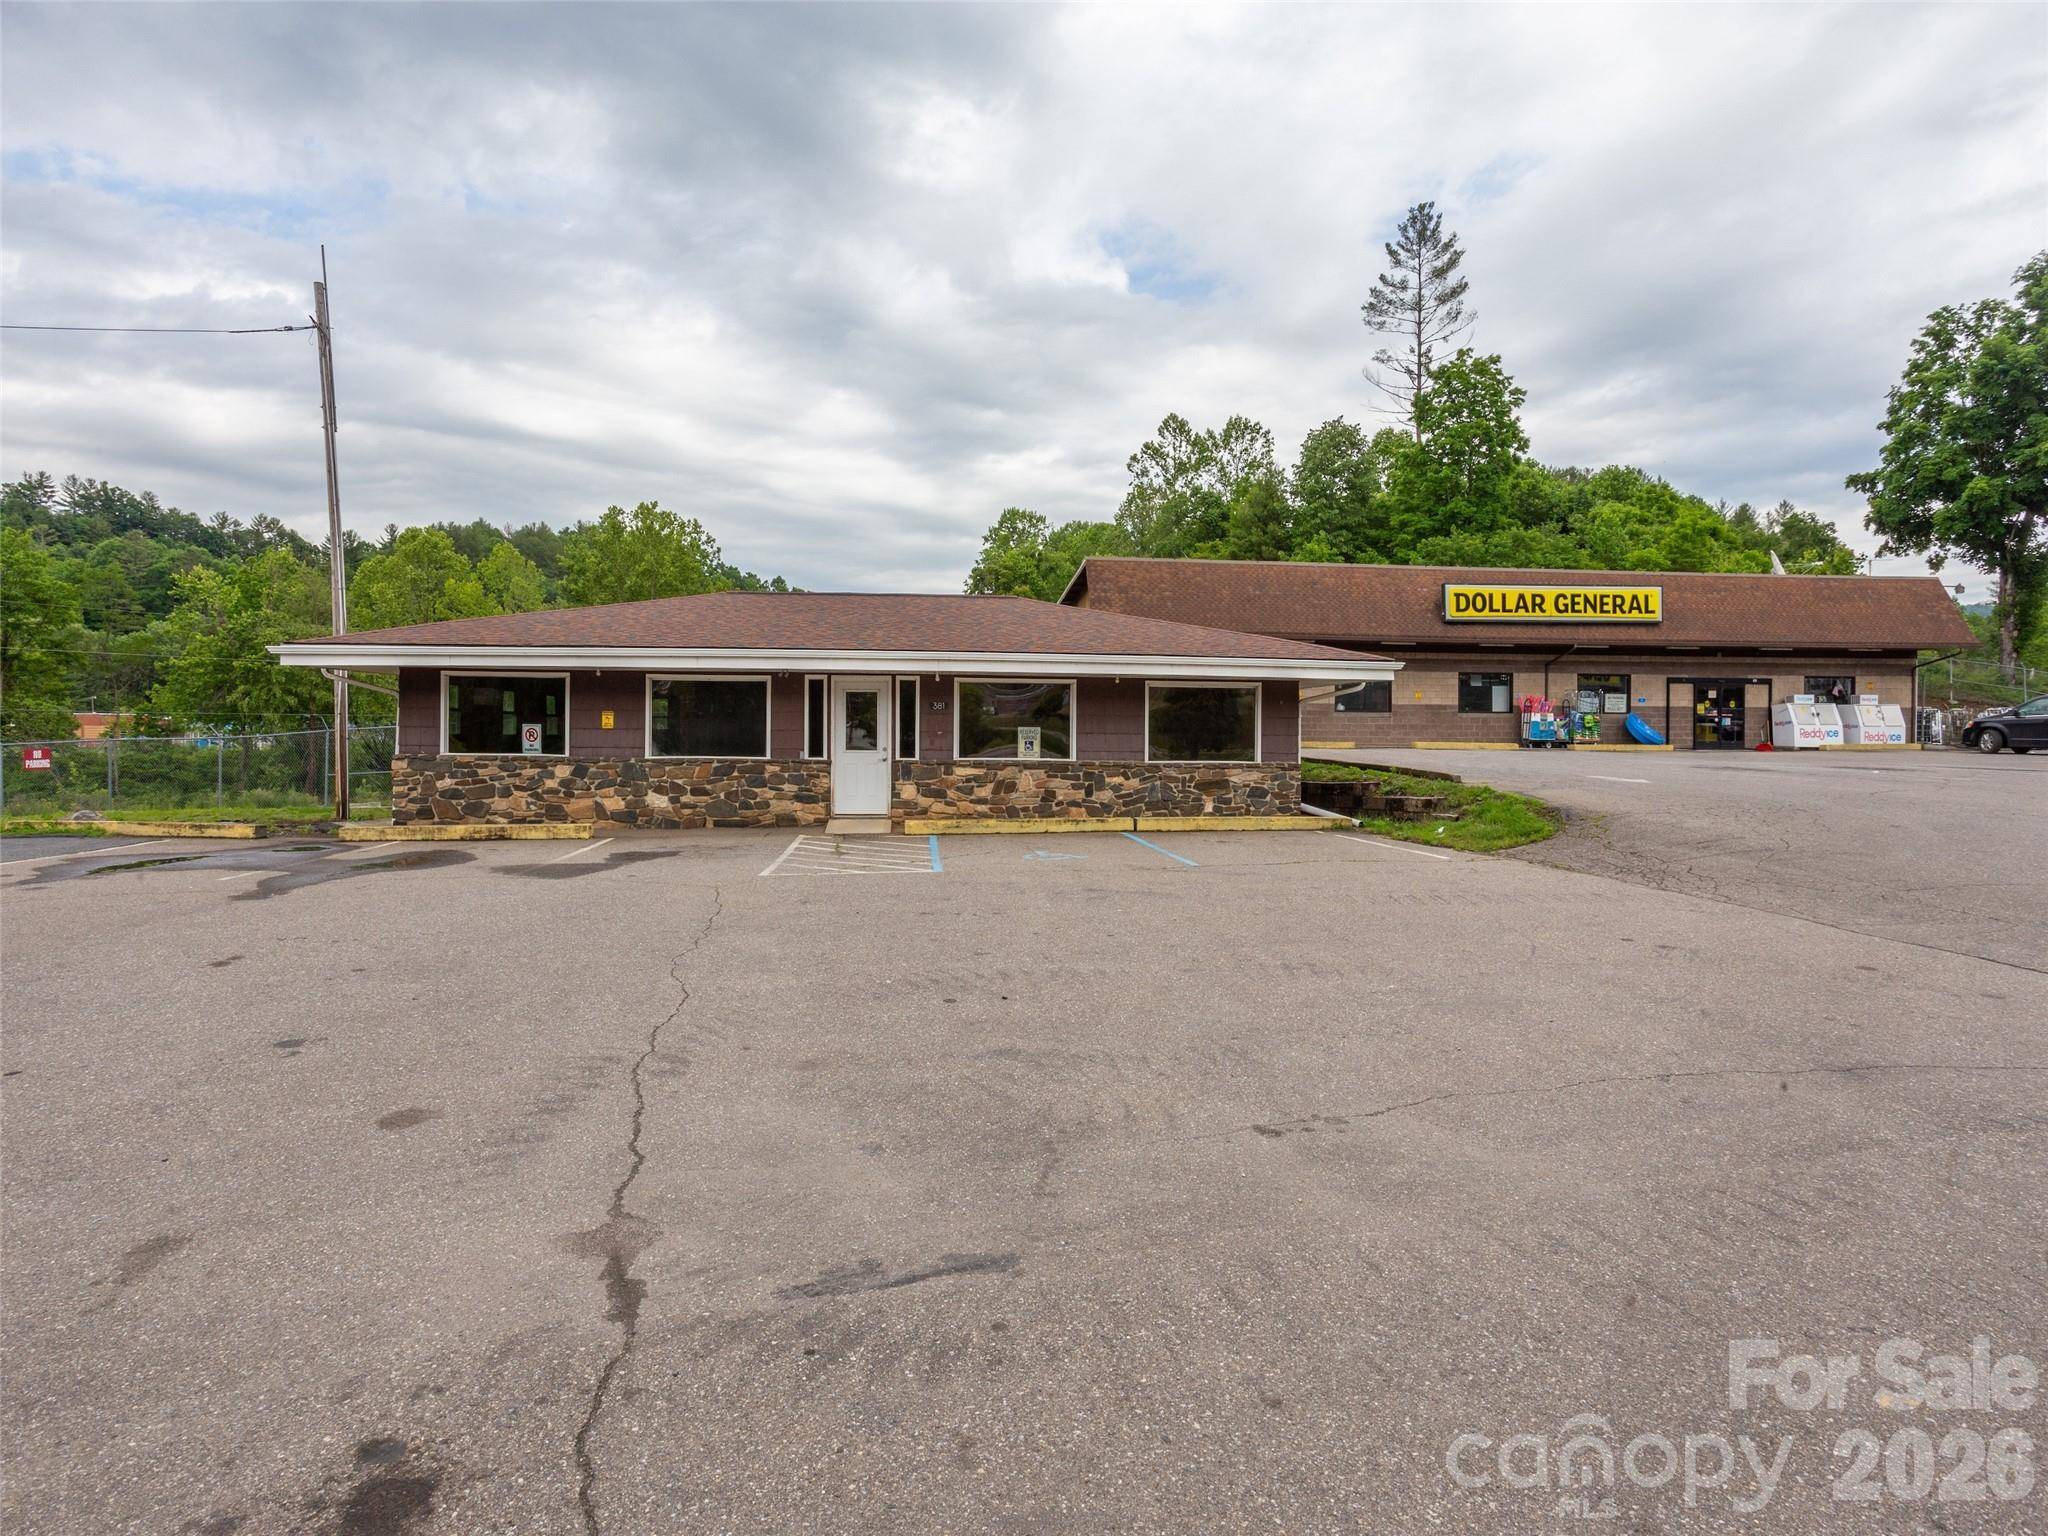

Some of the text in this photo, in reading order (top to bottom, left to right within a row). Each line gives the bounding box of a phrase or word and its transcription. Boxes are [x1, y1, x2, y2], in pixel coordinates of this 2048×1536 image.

[1454, 592, 1656, 615] DOLLAR GENERAL
[932, 702, 945, 710] 381
[33, 750, 42, 759] NO
[25, 759, 50, 769] PARKING
